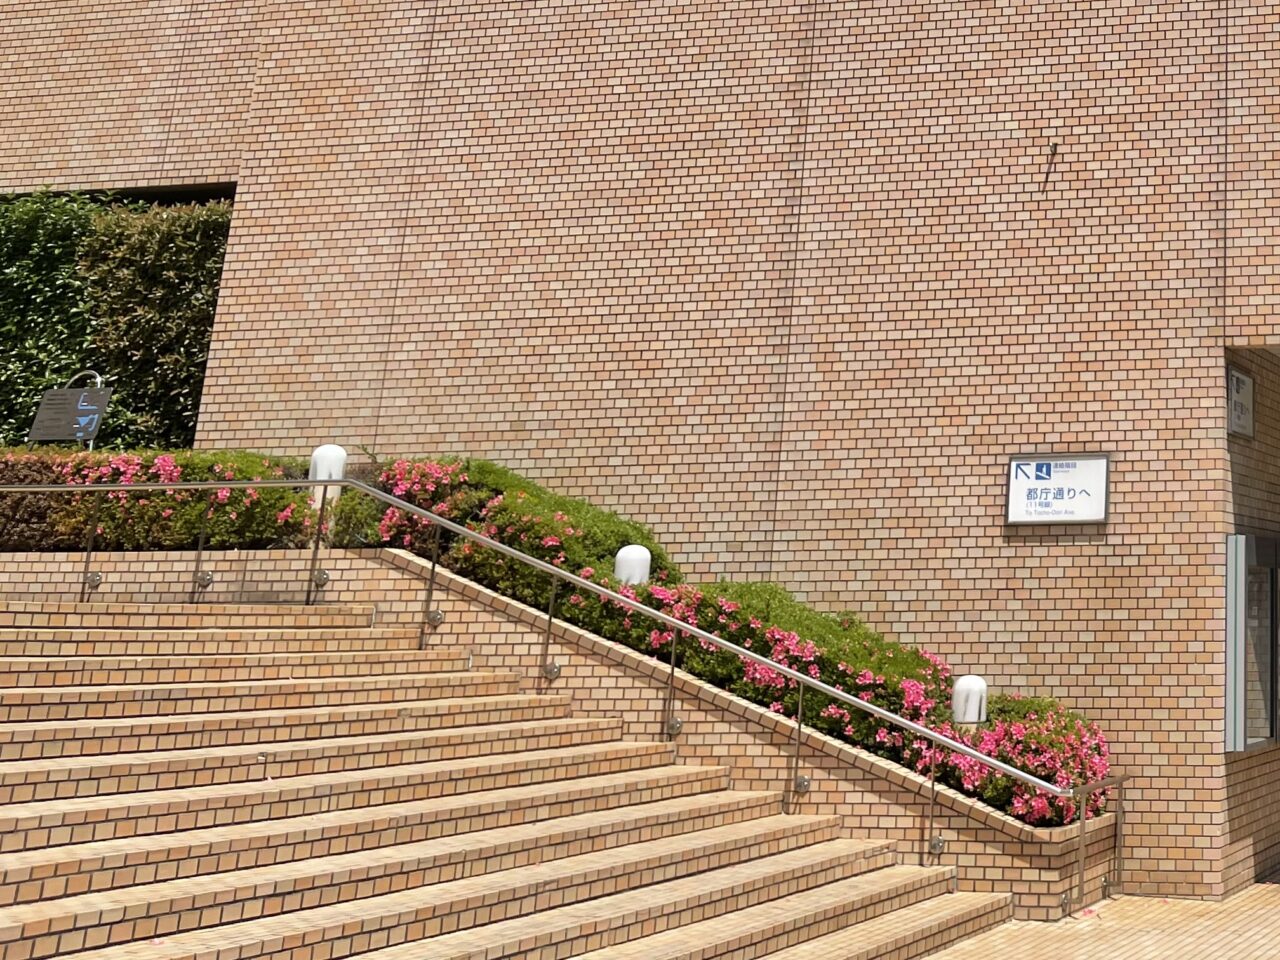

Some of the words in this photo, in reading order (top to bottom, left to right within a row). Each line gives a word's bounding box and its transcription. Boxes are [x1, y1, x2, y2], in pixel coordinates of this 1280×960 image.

[1026, 487, 1091, 500] 都庁通りへ
